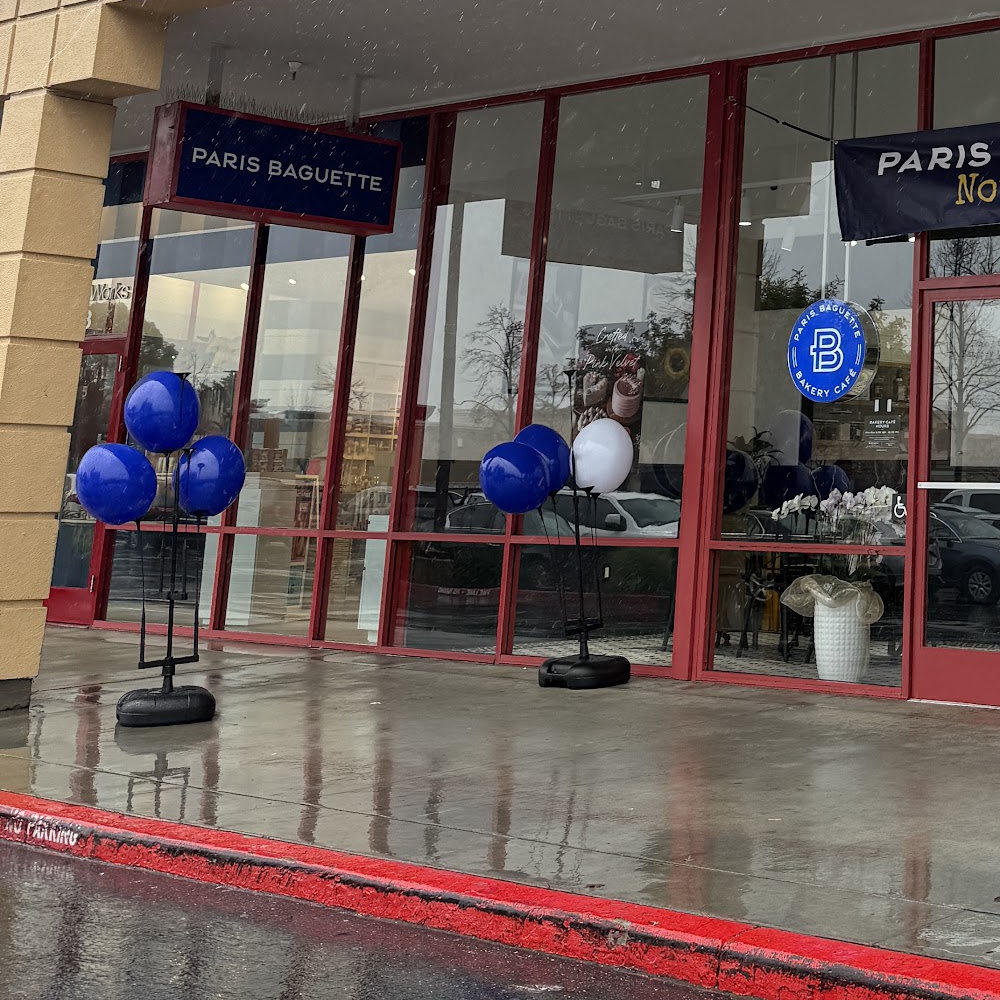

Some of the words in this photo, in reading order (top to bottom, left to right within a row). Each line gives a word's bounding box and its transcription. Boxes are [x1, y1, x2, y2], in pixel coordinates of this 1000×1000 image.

[192, 147, 260, 173] PARIS
[268, 159, 382, 192] BAGUETTE
[877, 142, 993, 176] PARIS
[91, 283, 132, 300] Works
[793, 310, 816, 341] PARIS
[819, 304, 861, 338] BAGUETTE
[582, 354, 607, 370] Pink
[609, 353, 641, 370] Velvet
[796, 370, 830, 397] BAKERY
[834, 368, 856, 394] CAFÉ
